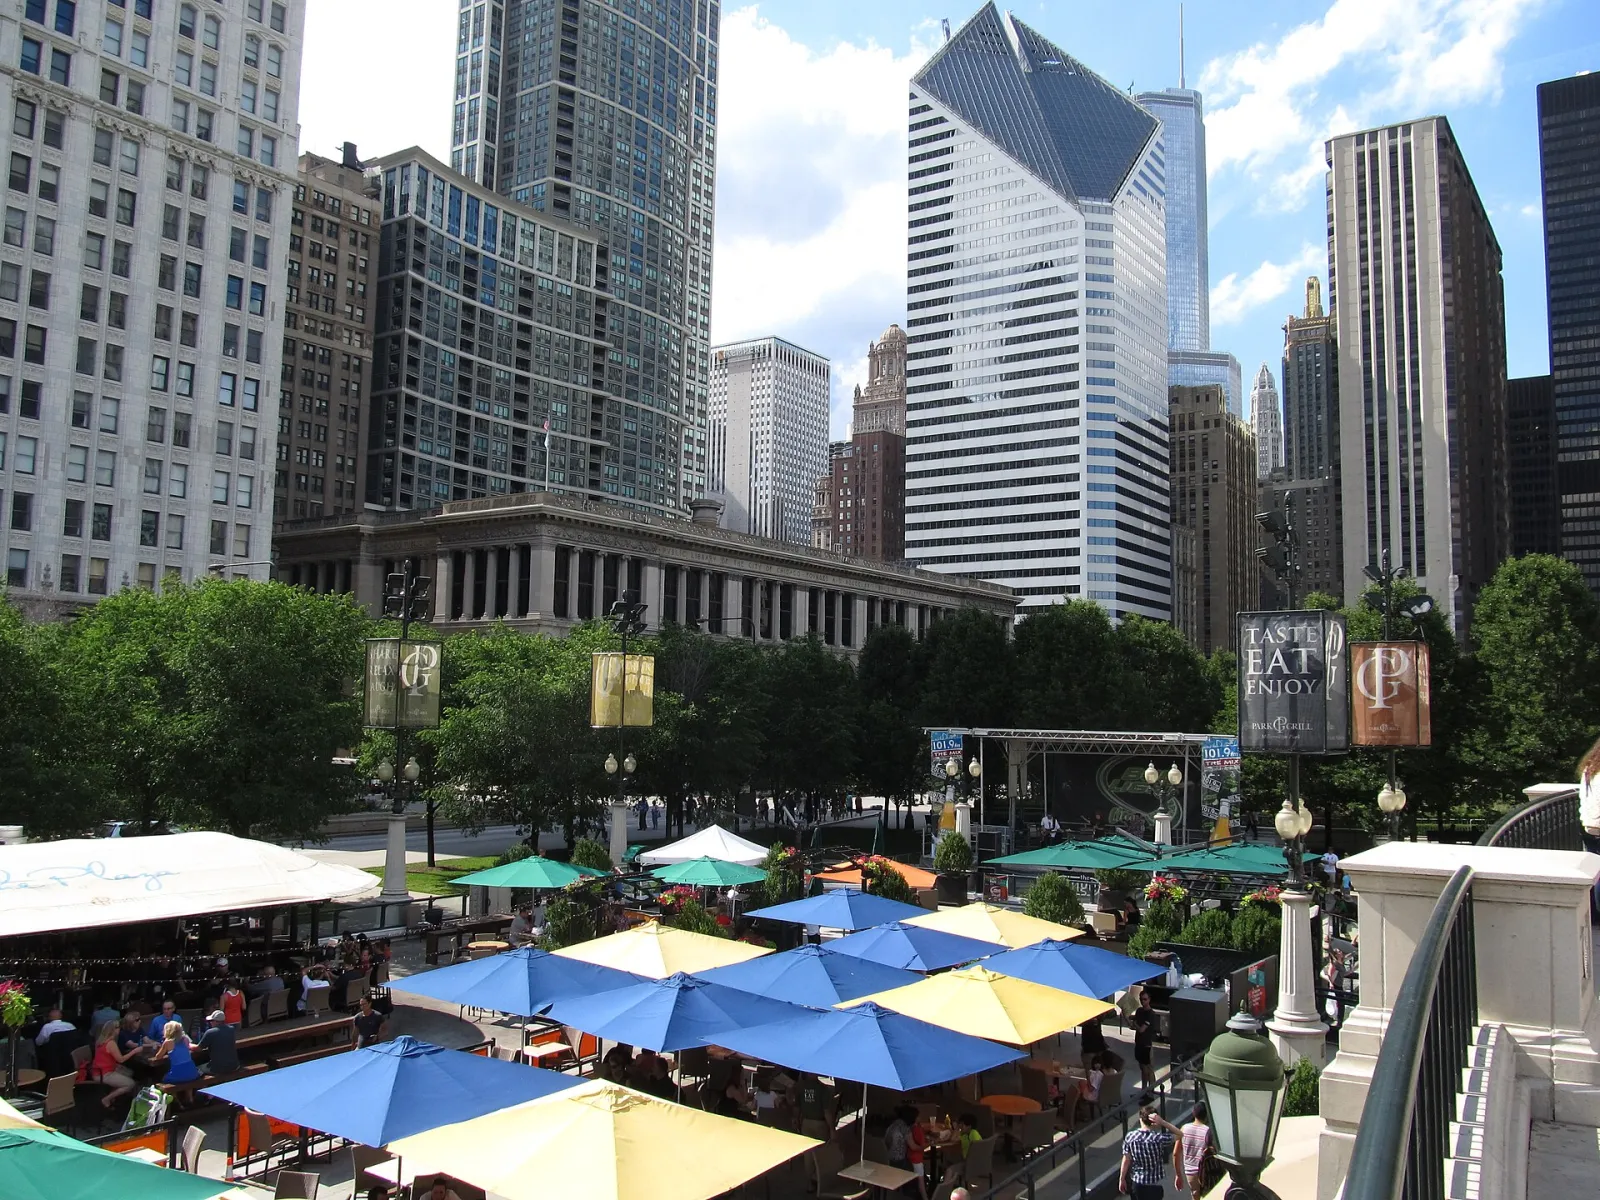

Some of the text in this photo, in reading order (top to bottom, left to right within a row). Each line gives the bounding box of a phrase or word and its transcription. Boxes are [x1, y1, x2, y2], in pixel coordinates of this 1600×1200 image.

[1245, 626, 1318, 644] TASTE
[1245, 648, 1318, 676] EAT
[1246, 679, 1318, 699] ENJOY
[1252, 722, 1273, 730] PARK
[1286, 722, 1314, 731] GRILL
